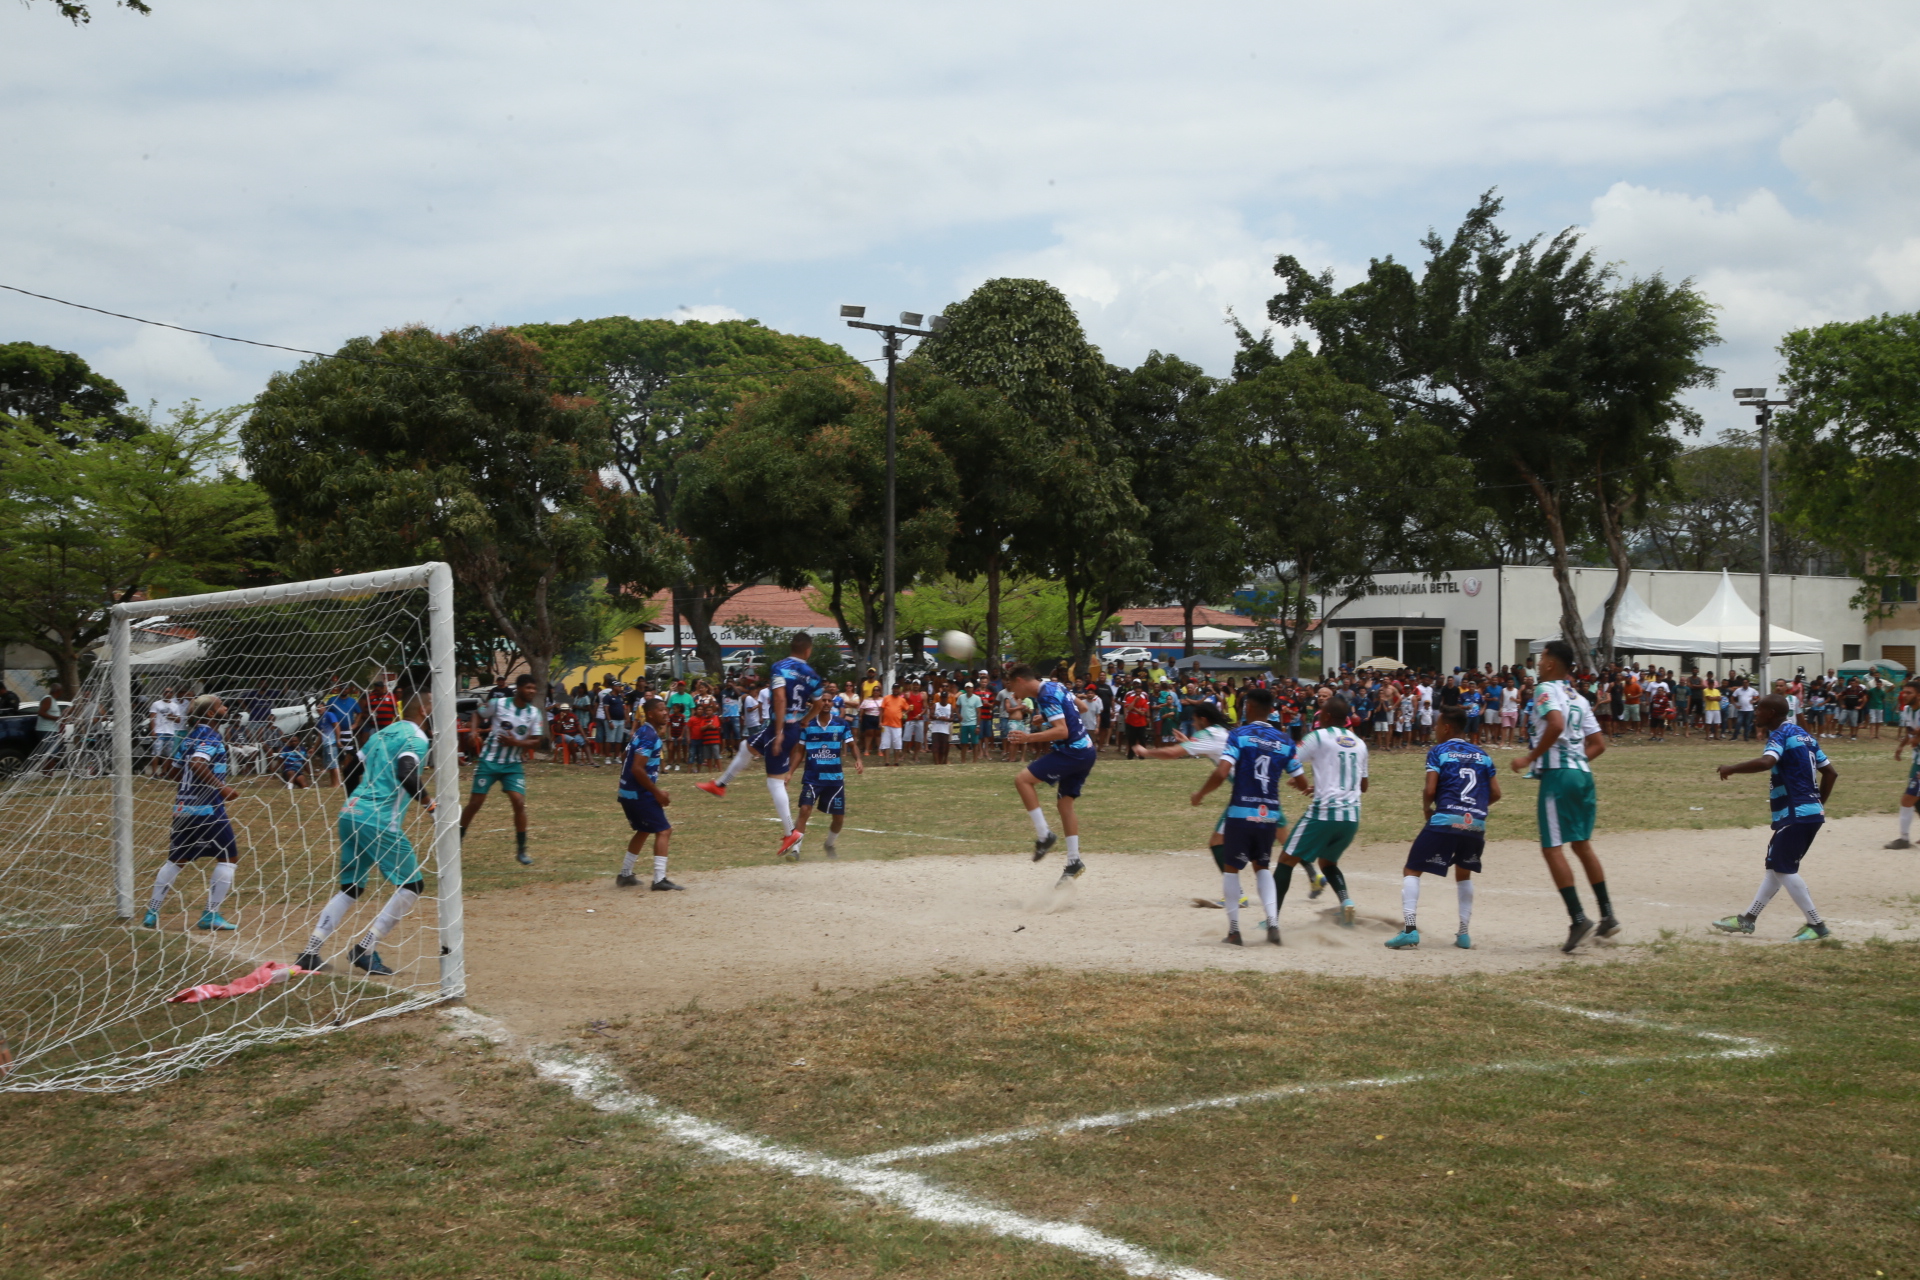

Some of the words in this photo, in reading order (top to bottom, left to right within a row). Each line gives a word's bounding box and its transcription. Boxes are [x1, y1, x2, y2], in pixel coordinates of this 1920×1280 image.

[1430, 582, 1460, 594] BETEL
[720, 632, 732, 640] DA
[791, 684, 805, 709] 5
[1254, 755, 1271, 794] 4
[1338, 751, 1358, 791] 11
[1459, 767, 1477, 805] 2
